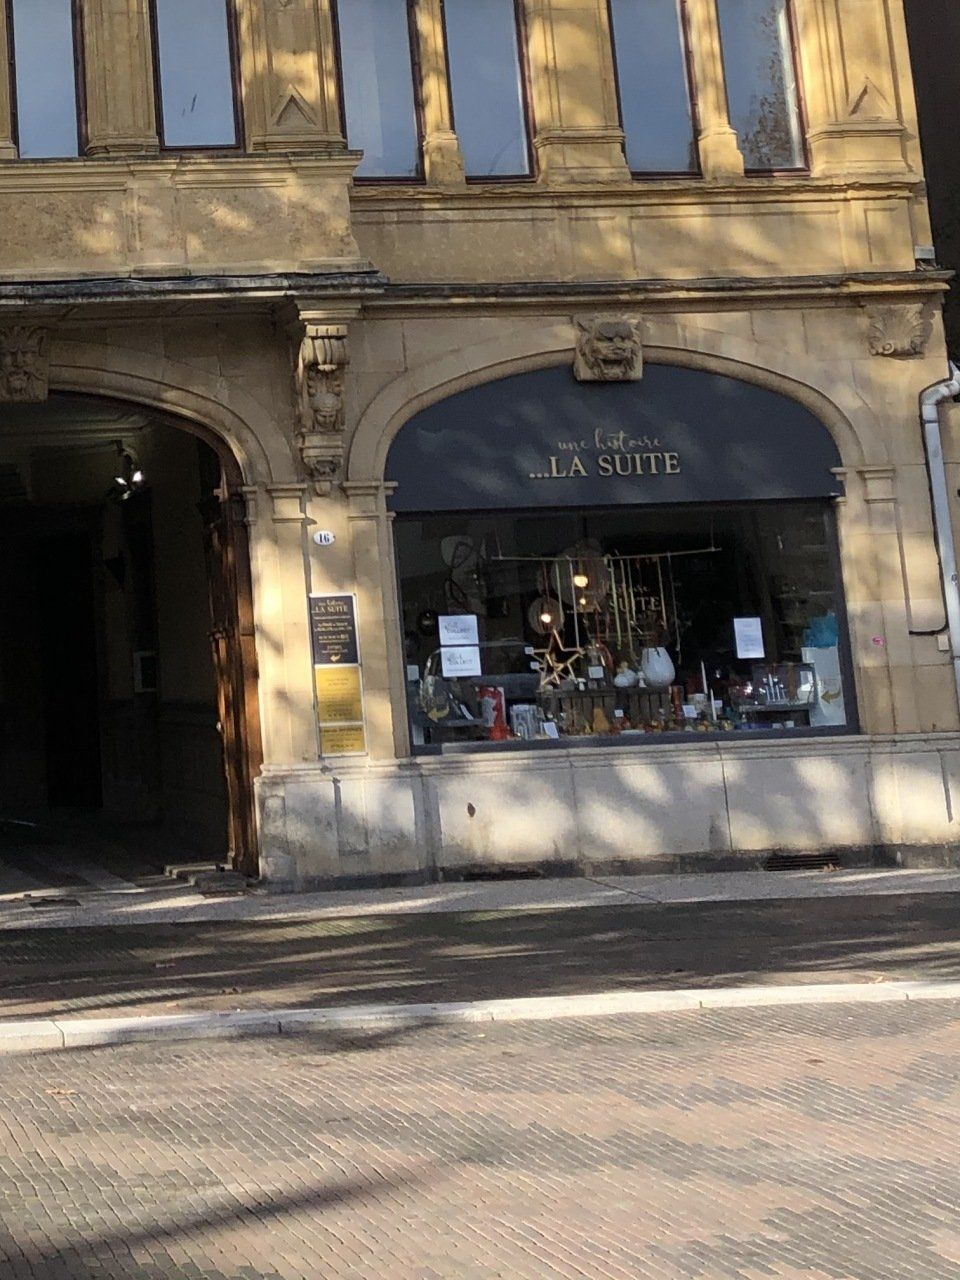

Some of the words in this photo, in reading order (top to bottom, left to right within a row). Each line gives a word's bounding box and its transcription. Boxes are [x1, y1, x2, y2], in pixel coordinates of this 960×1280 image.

[558, 439, 589, 452] une
[594, 427, 662, 453] histoire
[597, 452, 681, 477] SUITE
[319, 532, 330, 544] 16
